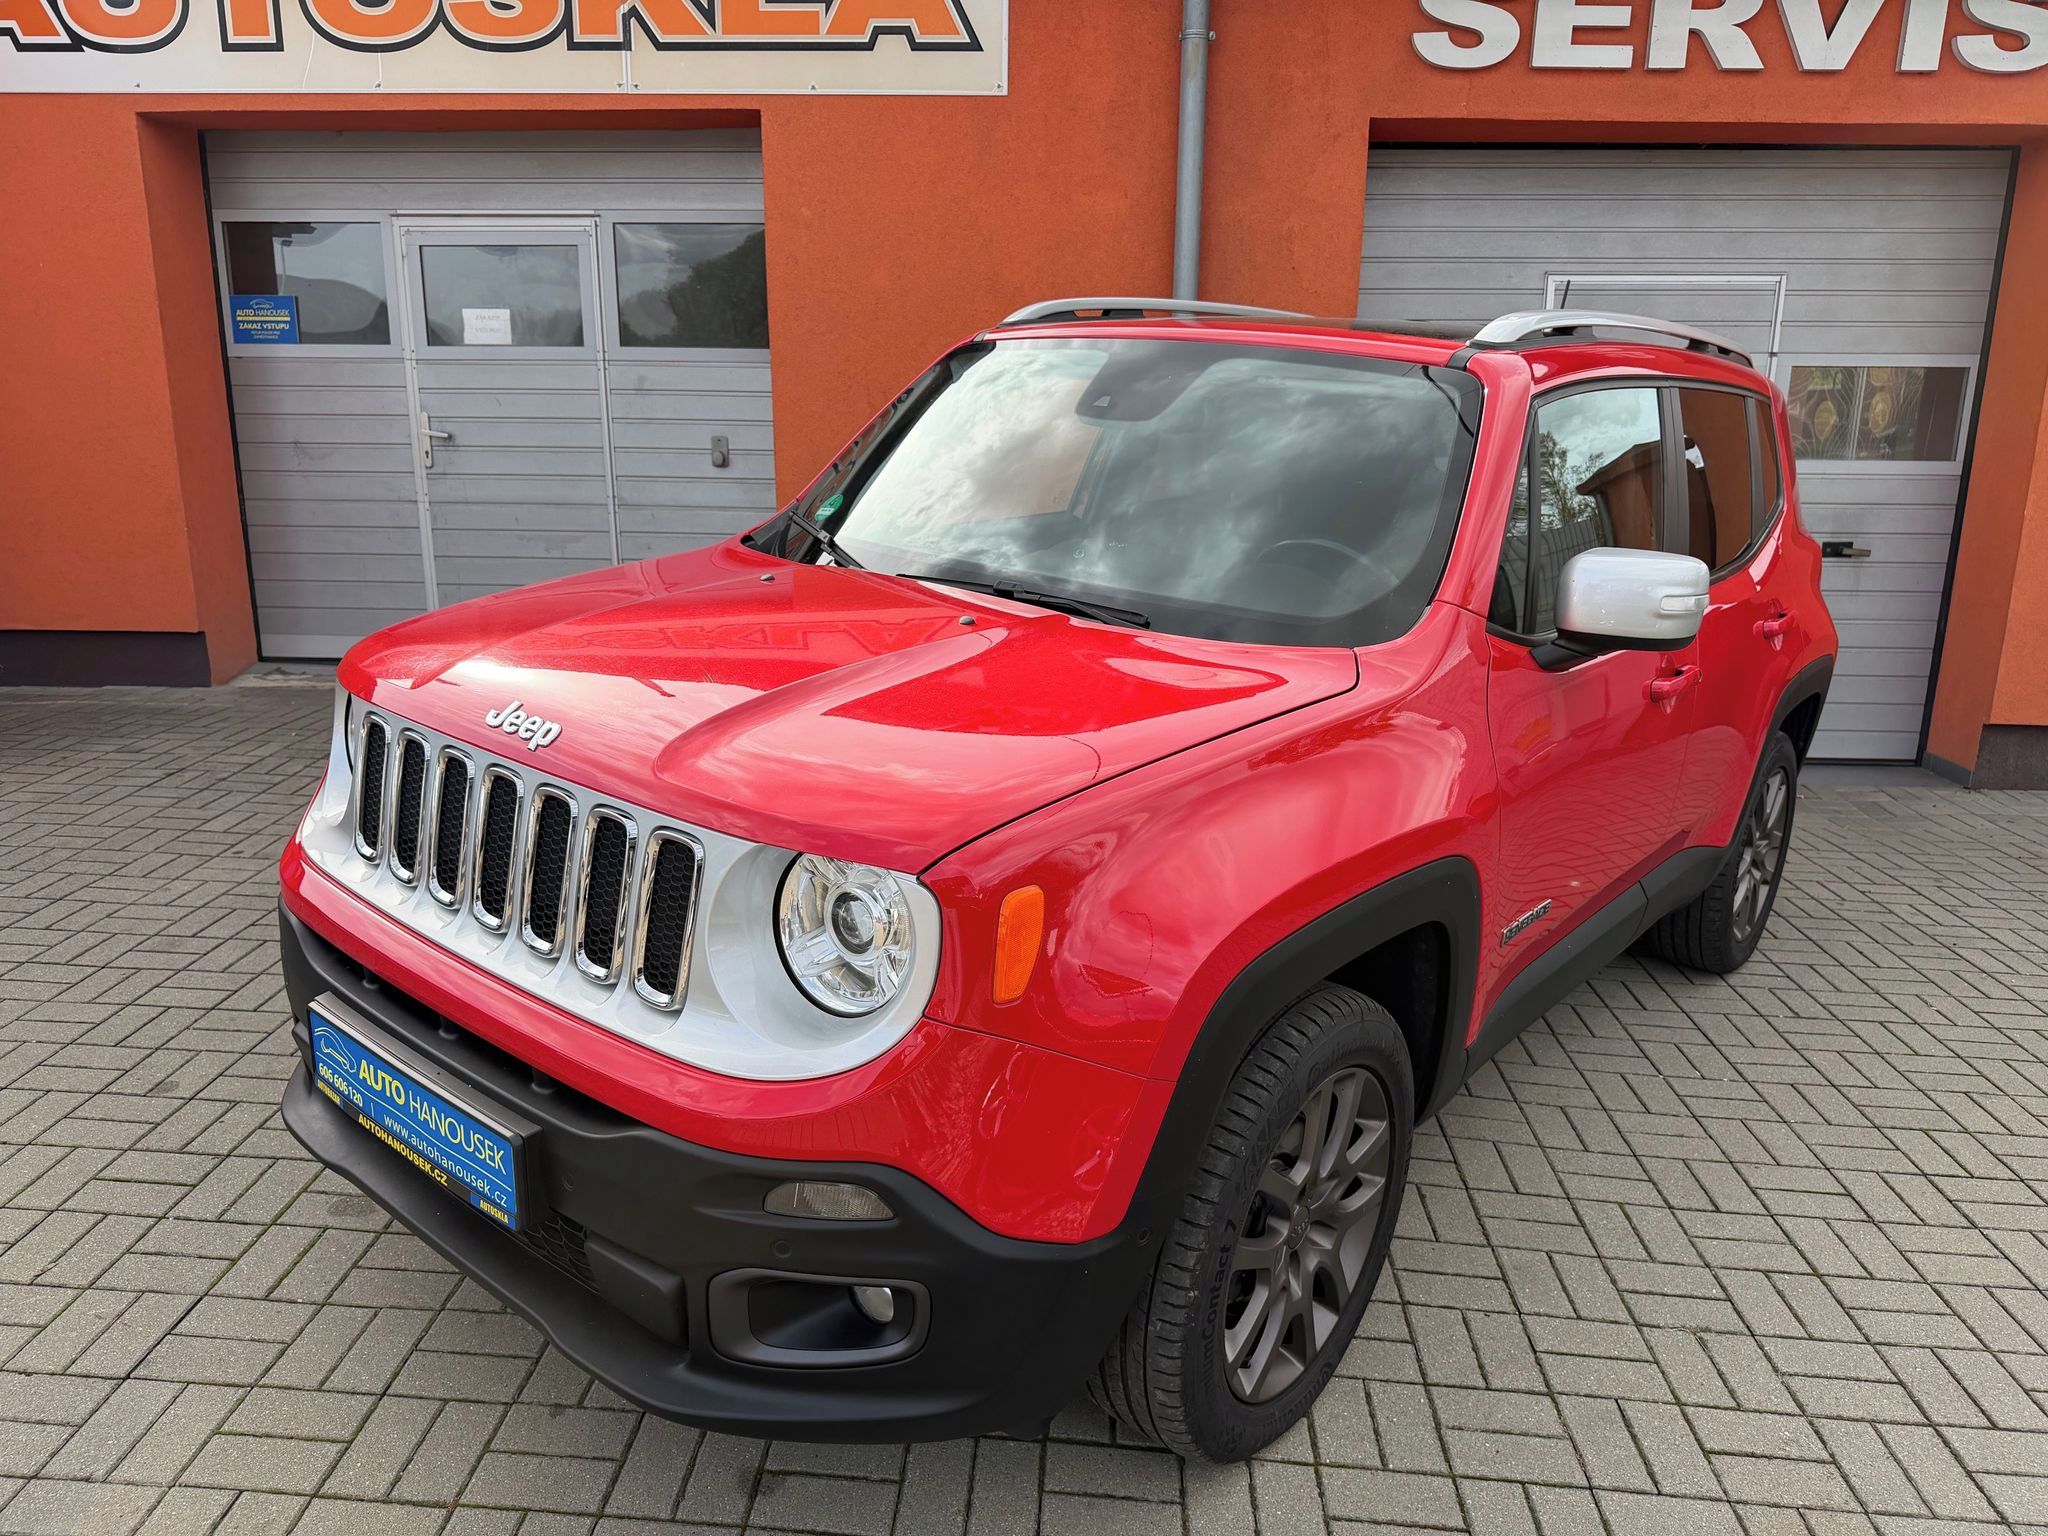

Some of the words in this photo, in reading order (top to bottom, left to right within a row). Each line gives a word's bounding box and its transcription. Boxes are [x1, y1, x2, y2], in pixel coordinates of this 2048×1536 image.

[1411, 0, 2048, 73] SERVIS
[485, 699, 562, 752] Jeep
[319, 1063, 333, 1083] 606
[334, 1074, 348, 1095] 606
[349, 1086, 363, 1107] 120
[359, 1059, 405, 1105] AUTO
[409, 1090, 506, 1175] HANOUSEK
[383, 1114, 507, 1208] www.autohanousek.cz
